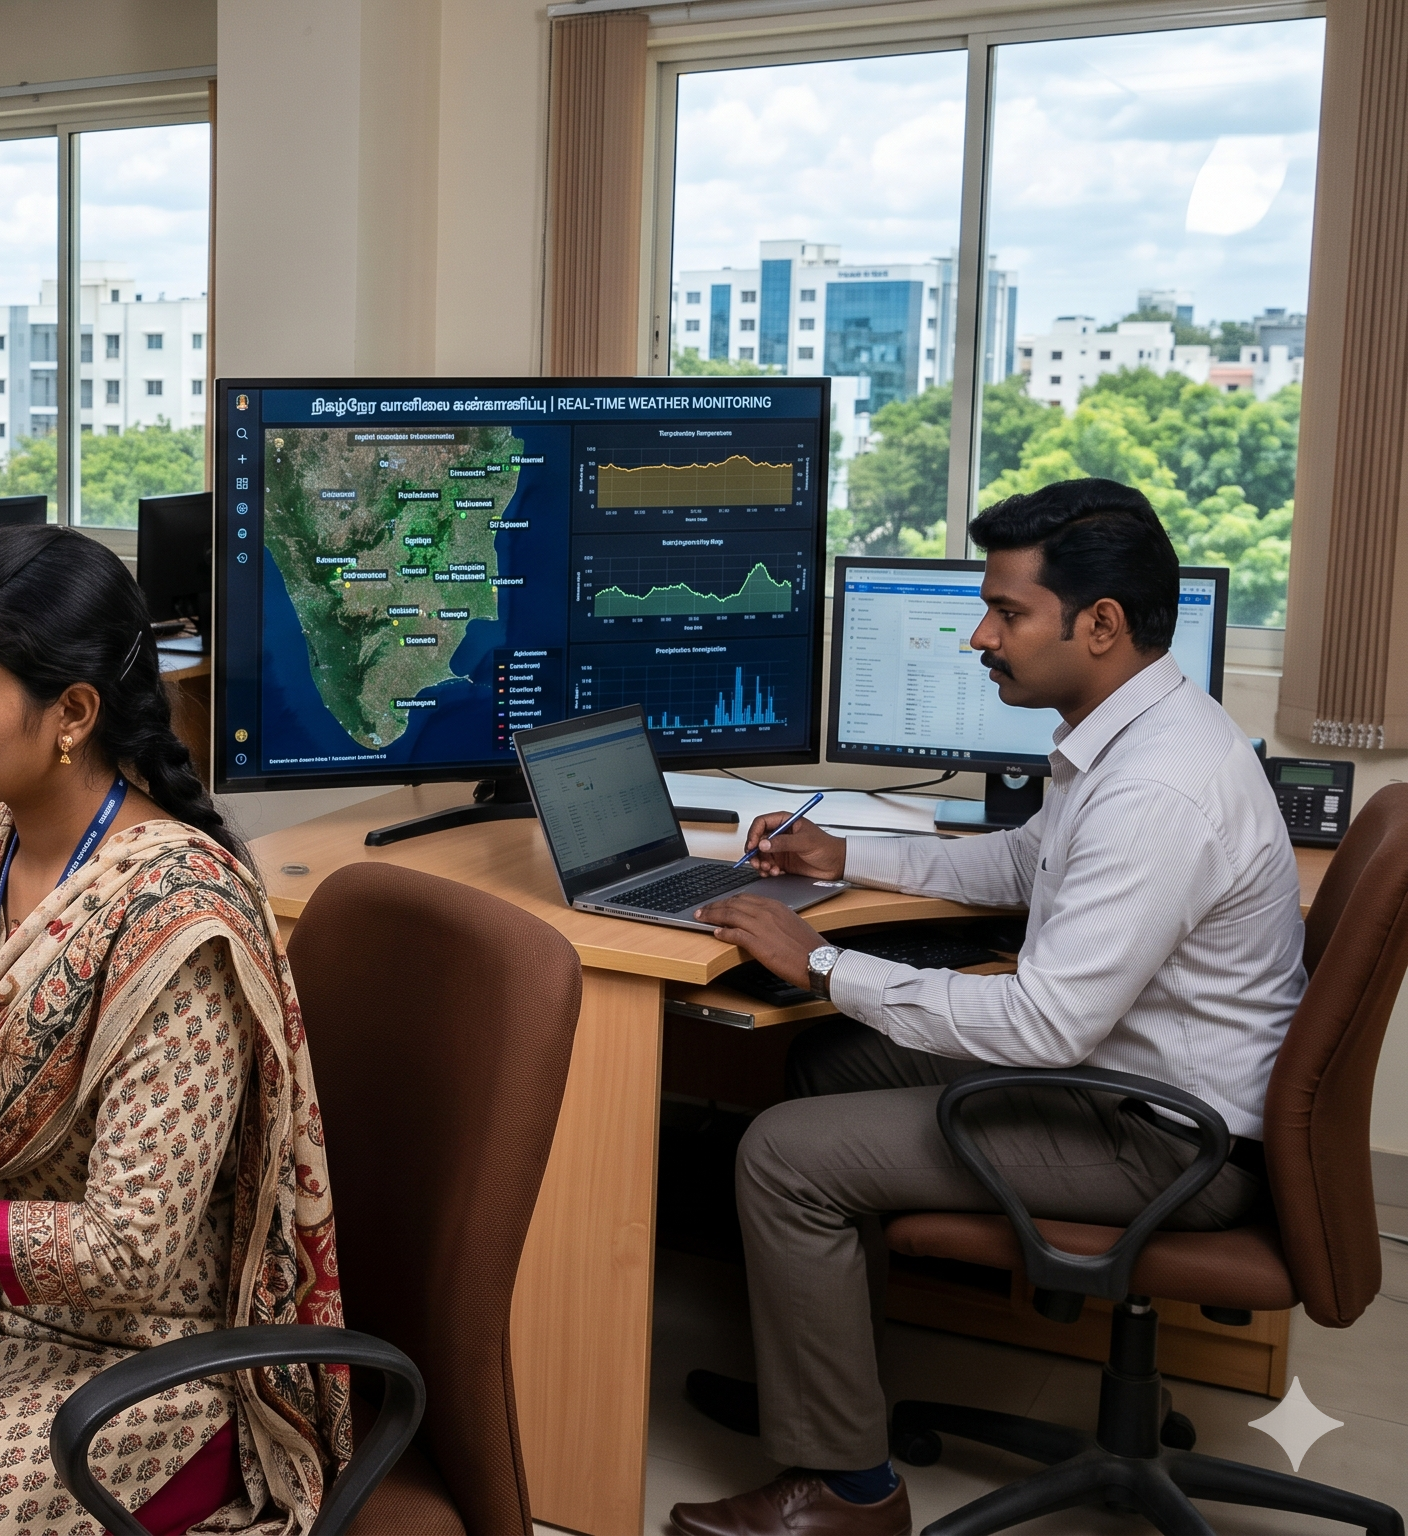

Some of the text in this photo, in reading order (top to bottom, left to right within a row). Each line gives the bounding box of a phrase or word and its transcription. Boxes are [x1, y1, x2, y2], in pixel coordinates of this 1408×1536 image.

[557, 397, 626, 410] REAL-TIME
[628, 396, 690, 410] WEATHER
[692, 396, 772, 409] MONITORING
